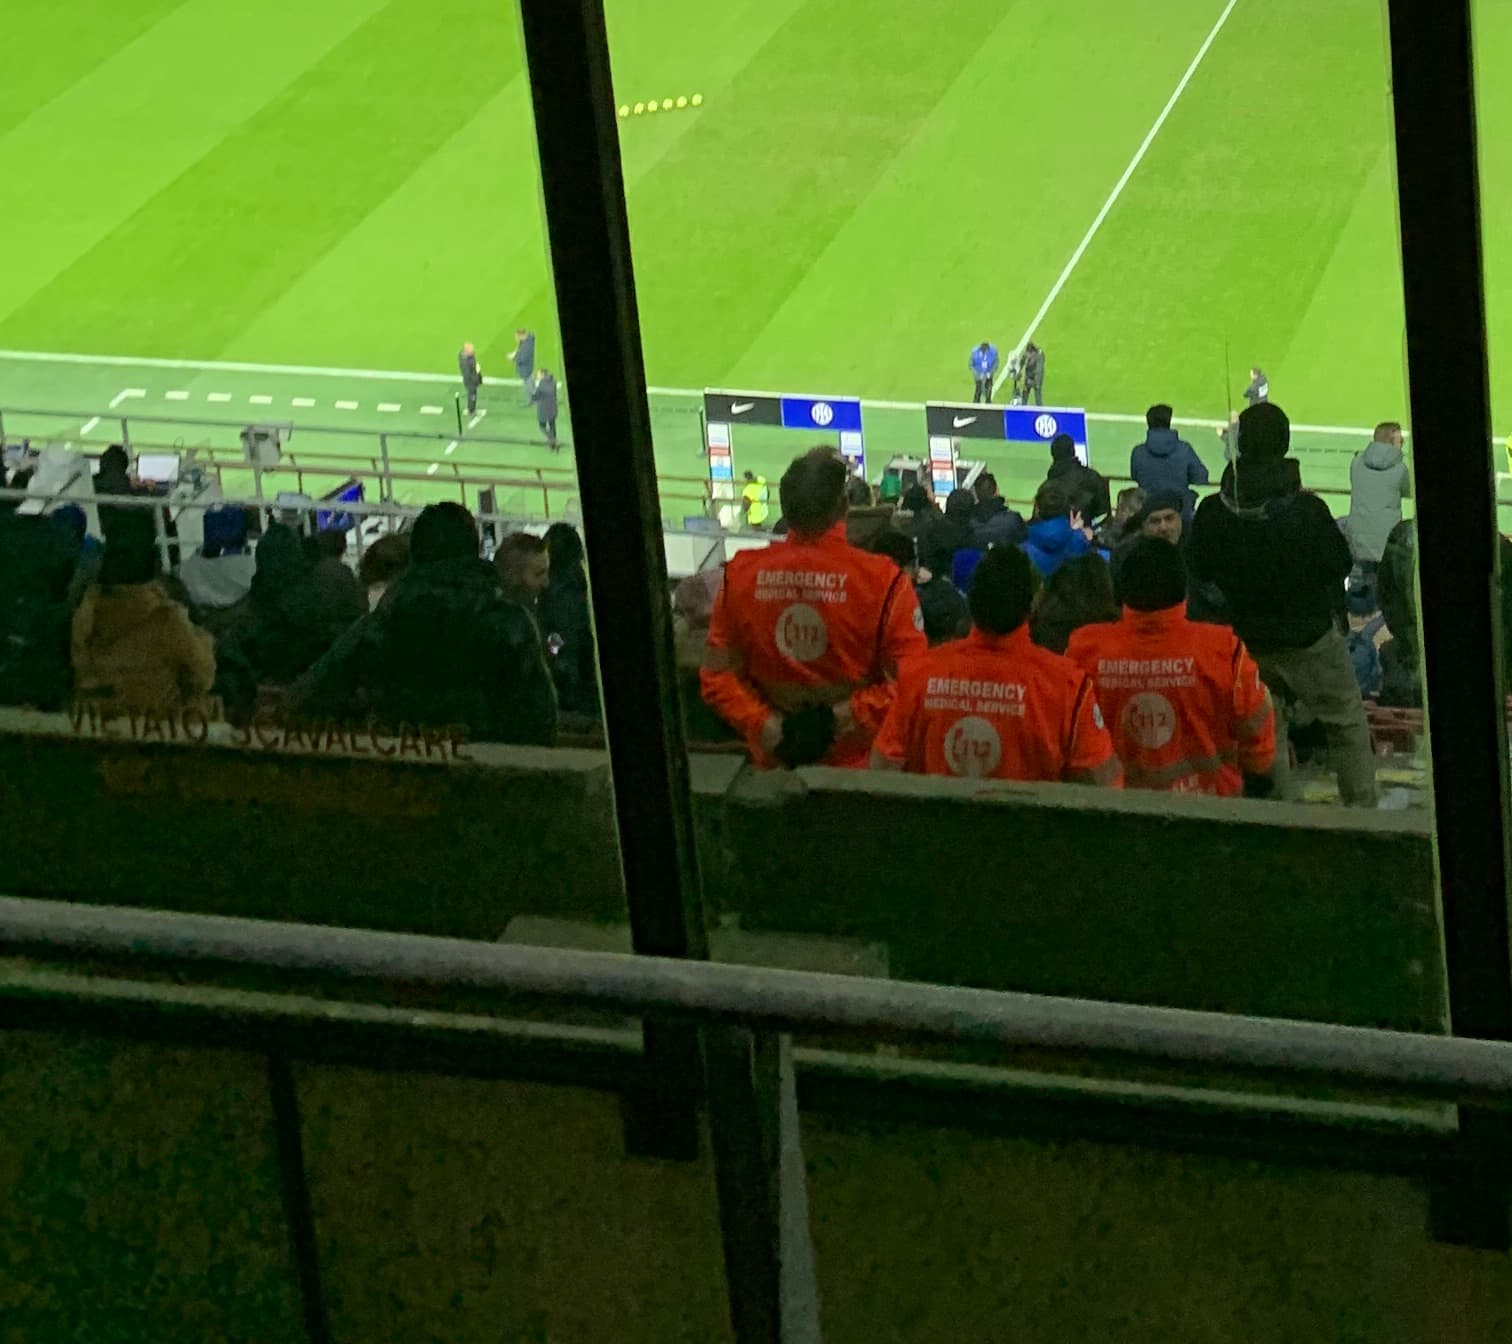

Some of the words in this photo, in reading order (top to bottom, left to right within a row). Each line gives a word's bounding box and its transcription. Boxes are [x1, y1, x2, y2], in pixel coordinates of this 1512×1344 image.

[756, 568, 848, 589] EMERGENCY
[1097, 657, 1195, 675] EMERGENCY
[926, 677, 1027, 703] EMERGENCY
[67, 701, 209, 744] VIETATO
[230, 714, 473, 762] SCAVALCARE
